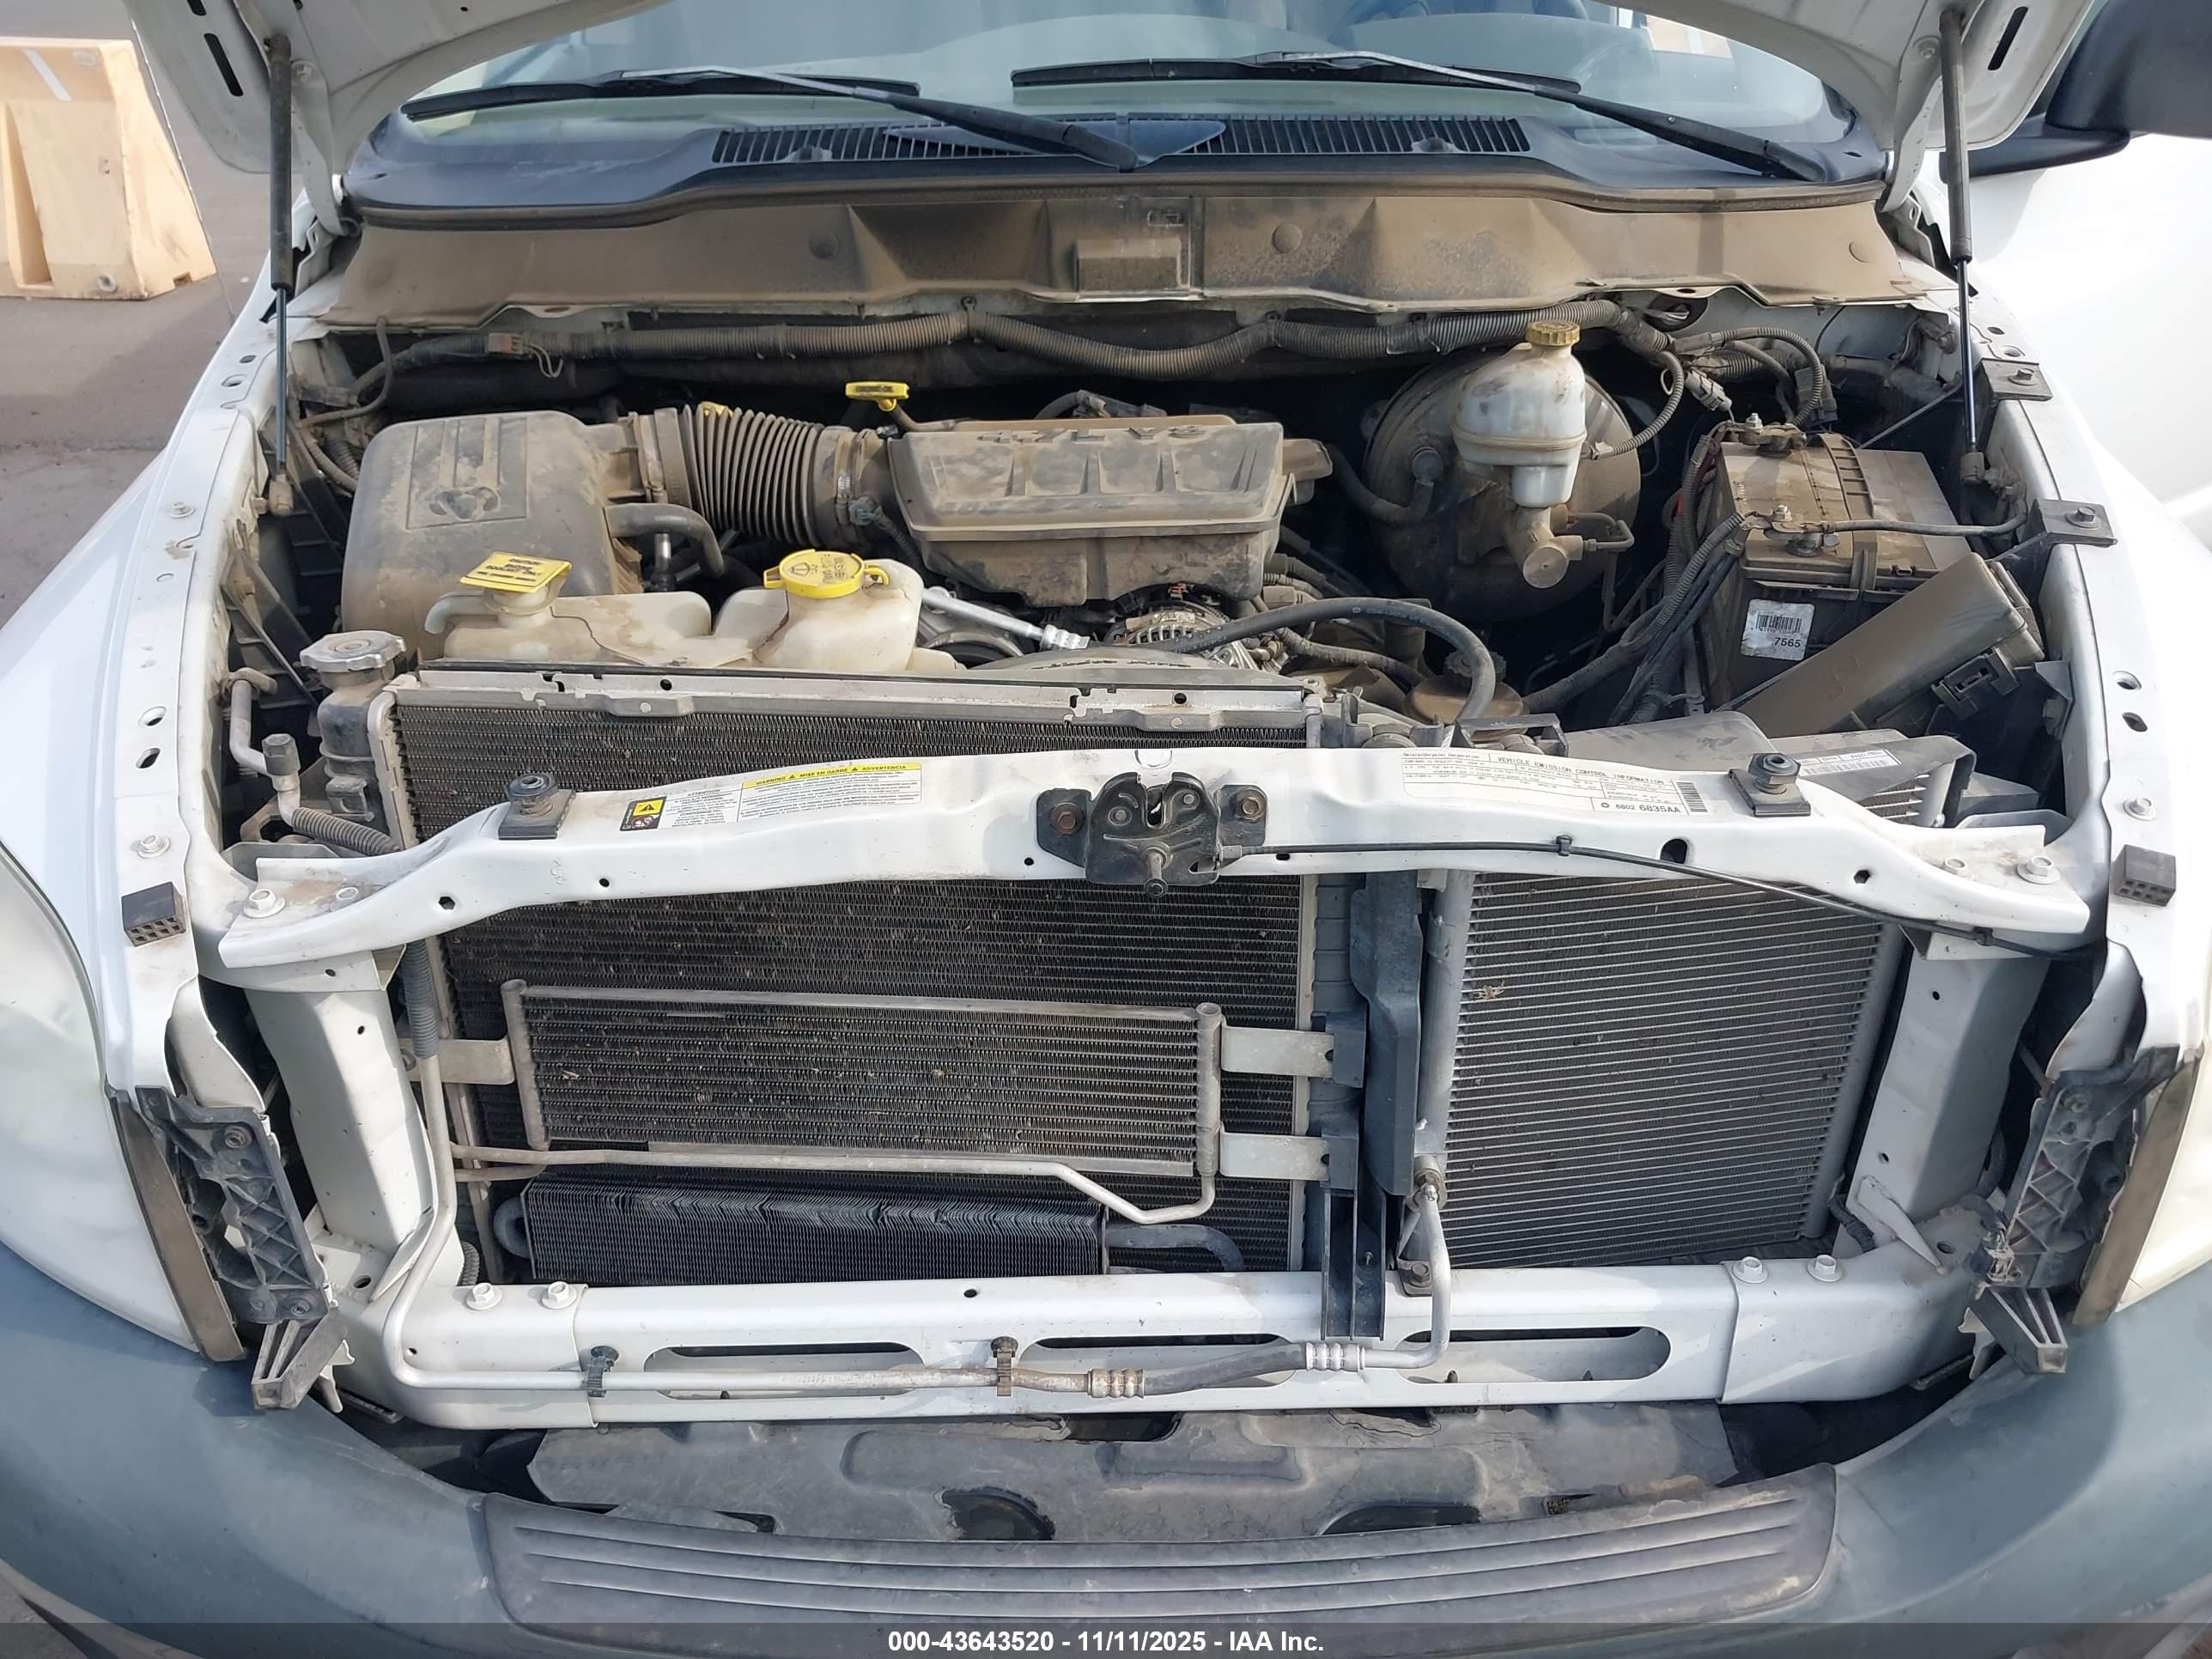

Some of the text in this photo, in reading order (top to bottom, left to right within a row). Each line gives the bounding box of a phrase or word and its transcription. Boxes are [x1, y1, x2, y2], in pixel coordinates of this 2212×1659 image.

[1774, 637, 1801, 647] 7565
[1497, 756, 1530, 765] VEHICLE
[1534, 761, 1572, 773] EMISSION
[1575, 769, 1607, 777] CONTROL
[1613, 774, 1664, 785] INFORMATION
[756, 776, 786, 785] WARNING
[1639, 805, 1681, 813] 6835AA
